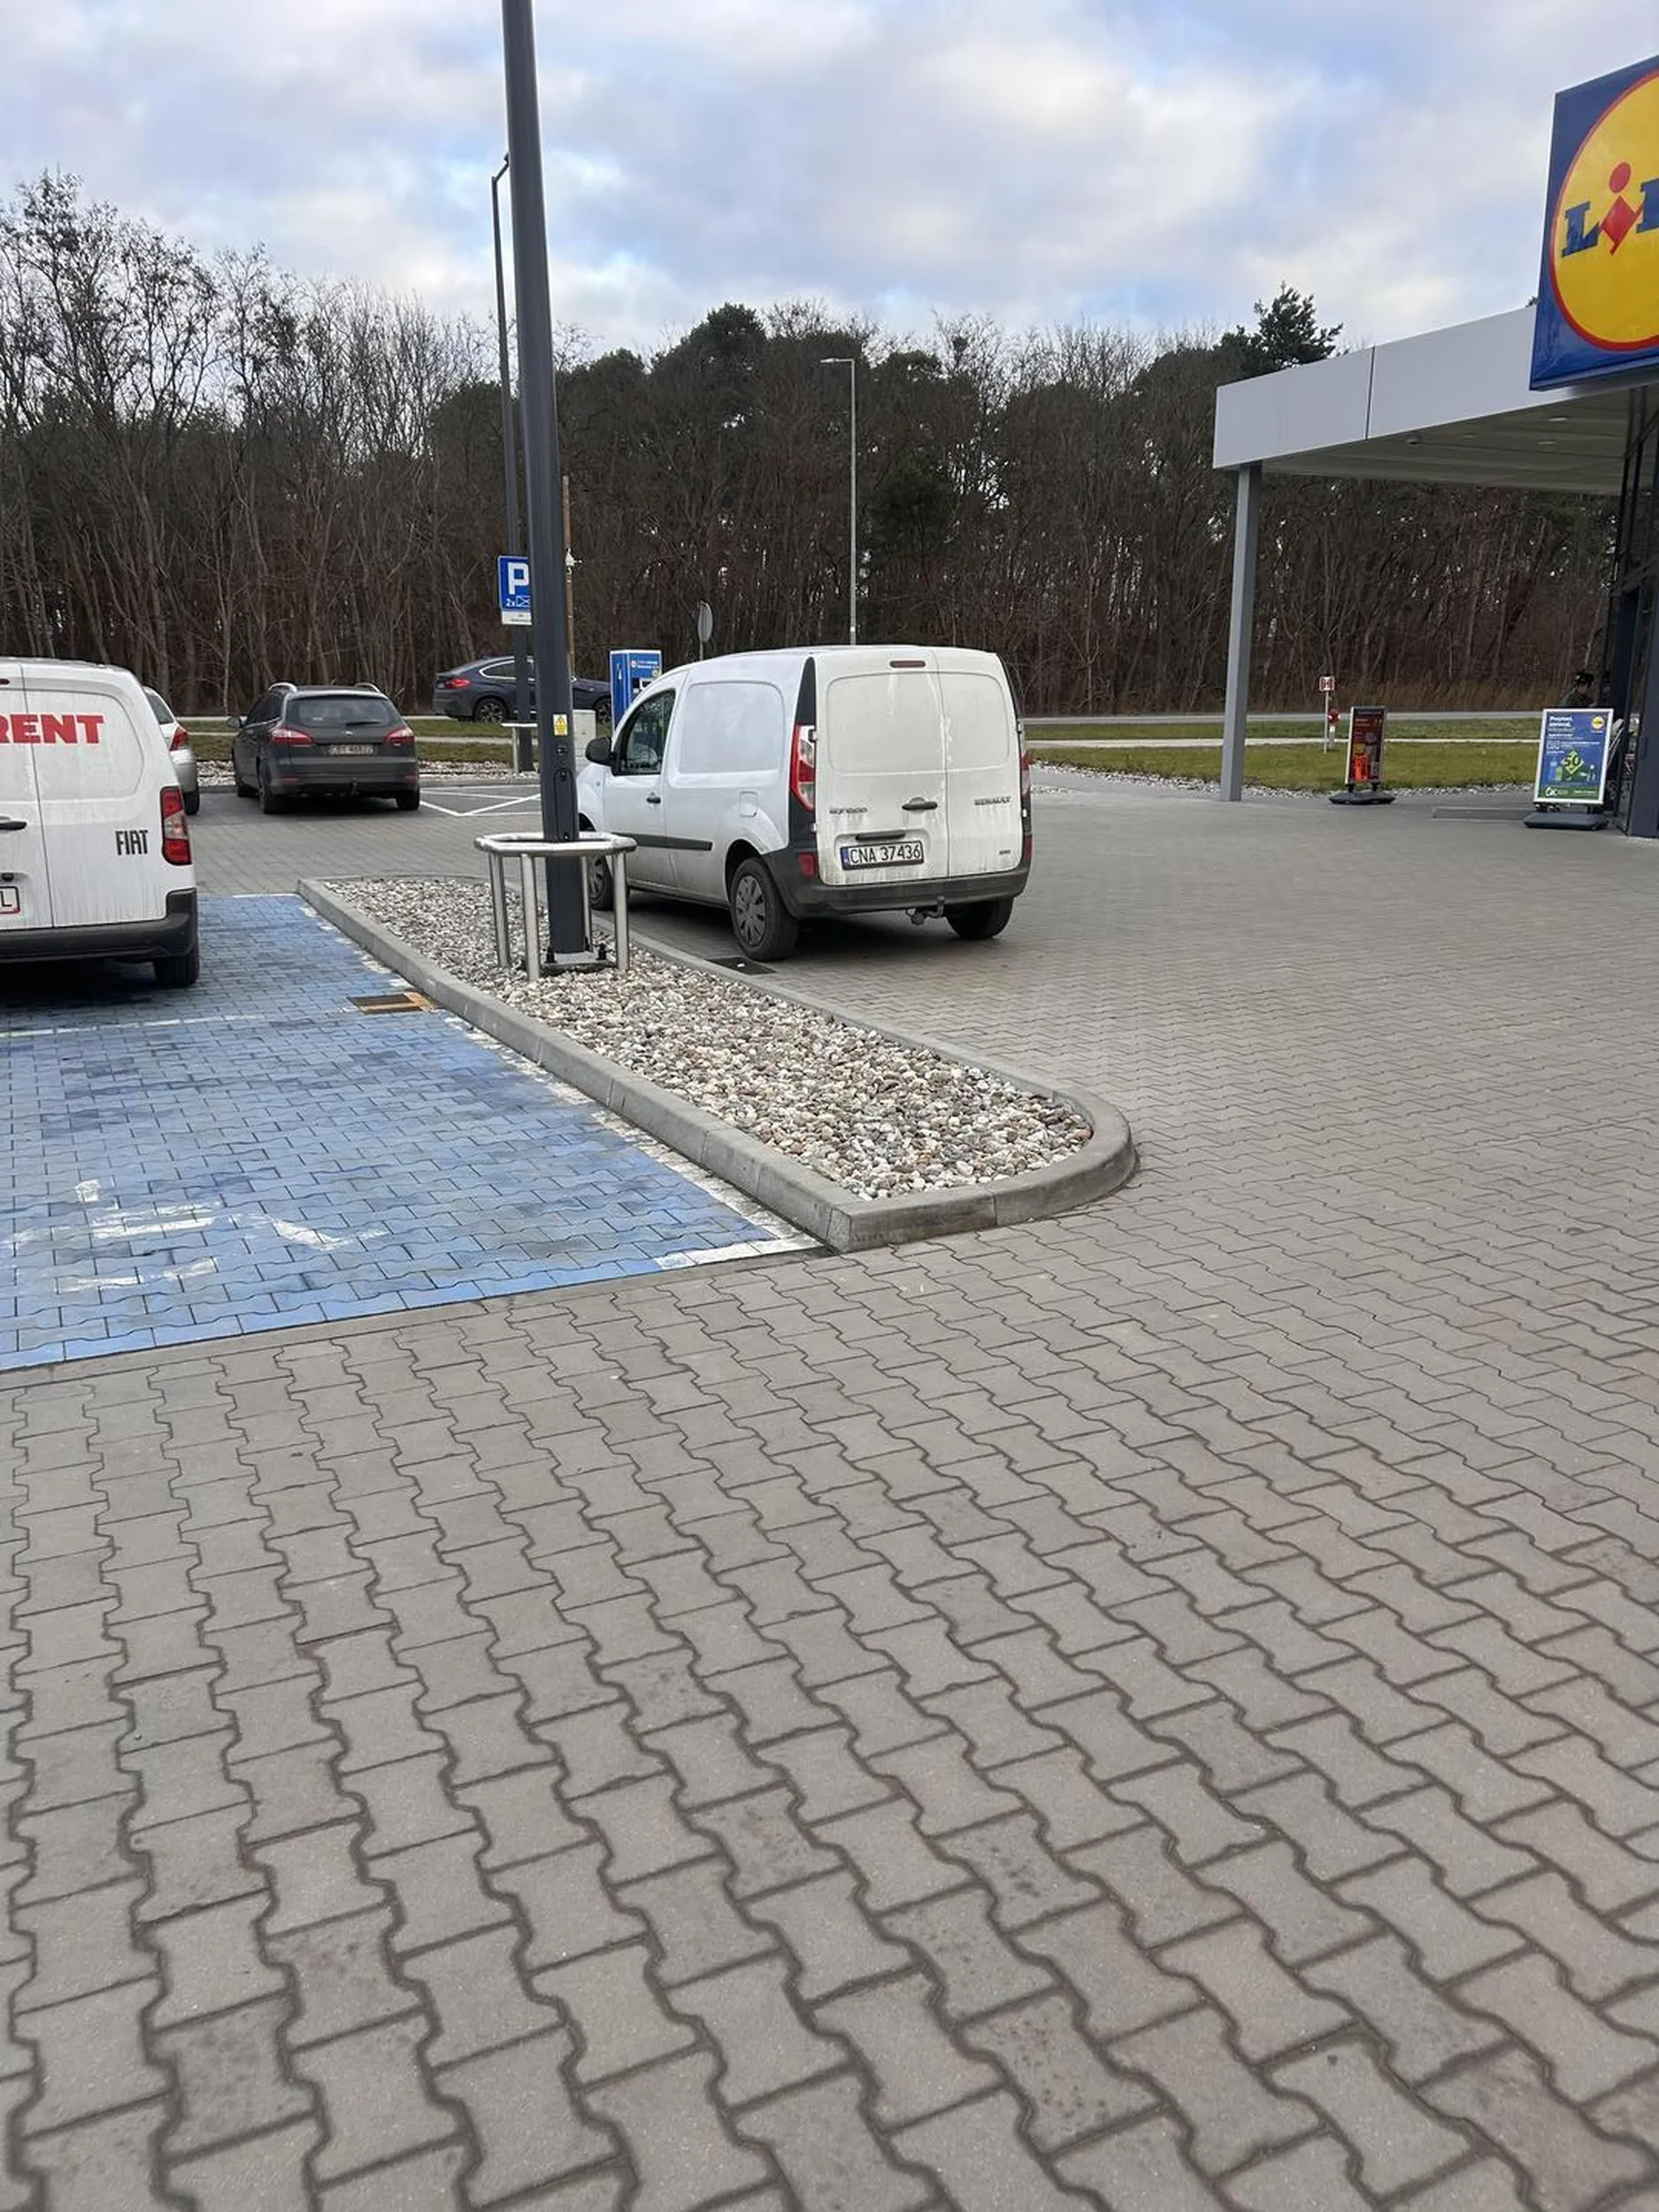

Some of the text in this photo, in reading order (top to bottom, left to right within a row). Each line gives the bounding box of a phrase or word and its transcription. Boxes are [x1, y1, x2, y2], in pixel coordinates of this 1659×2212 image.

[507, 562, 529, 595] P
[115, 829, 149, 856] FIAT
[850, 844, 920, 864] CNA 37436
